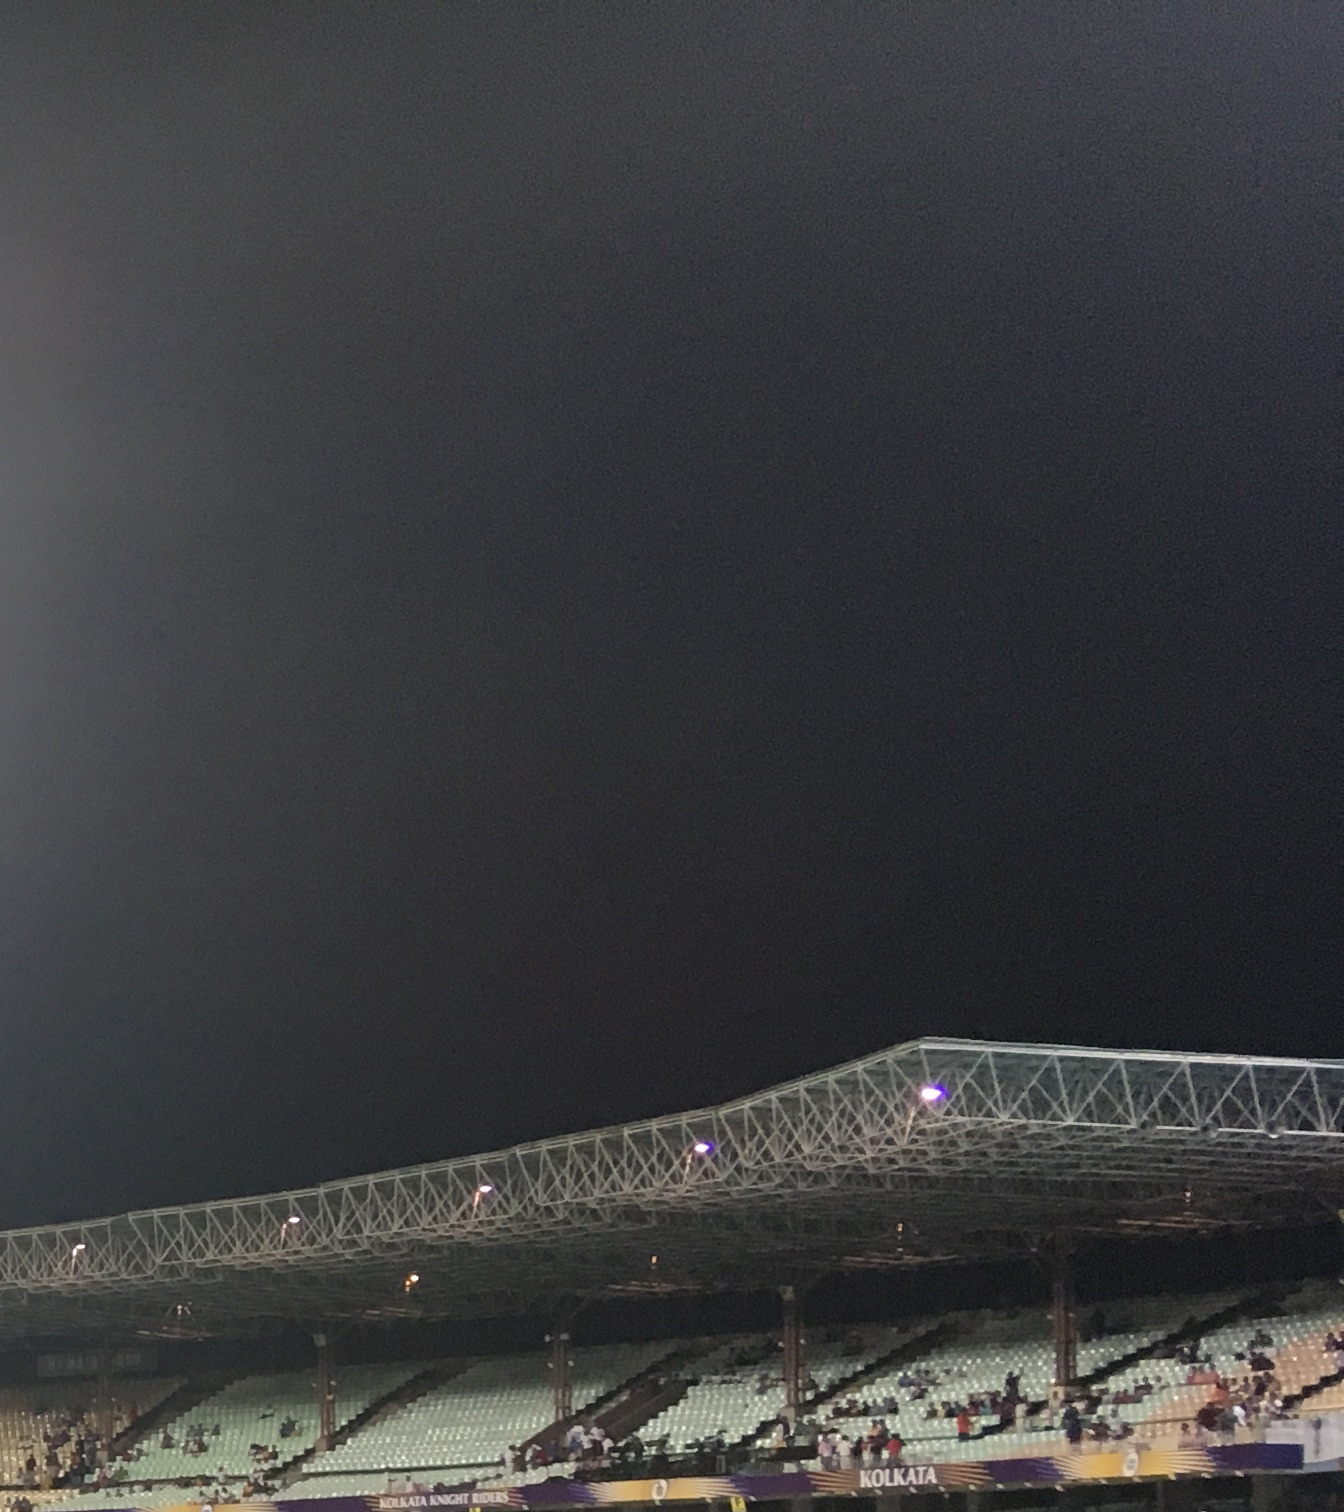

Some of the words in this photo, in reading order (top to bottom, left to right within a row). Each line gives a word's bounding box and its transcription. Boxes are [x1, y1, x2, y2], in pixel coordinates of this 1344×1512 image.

[860, 1466, 938, 1488] KOLKATA
[379, 1496, 427, 1509] KOLKATA
[429, 1493, 469, 1505] KNIGHT
[472, 1491, 509, 1504] RIDERS
